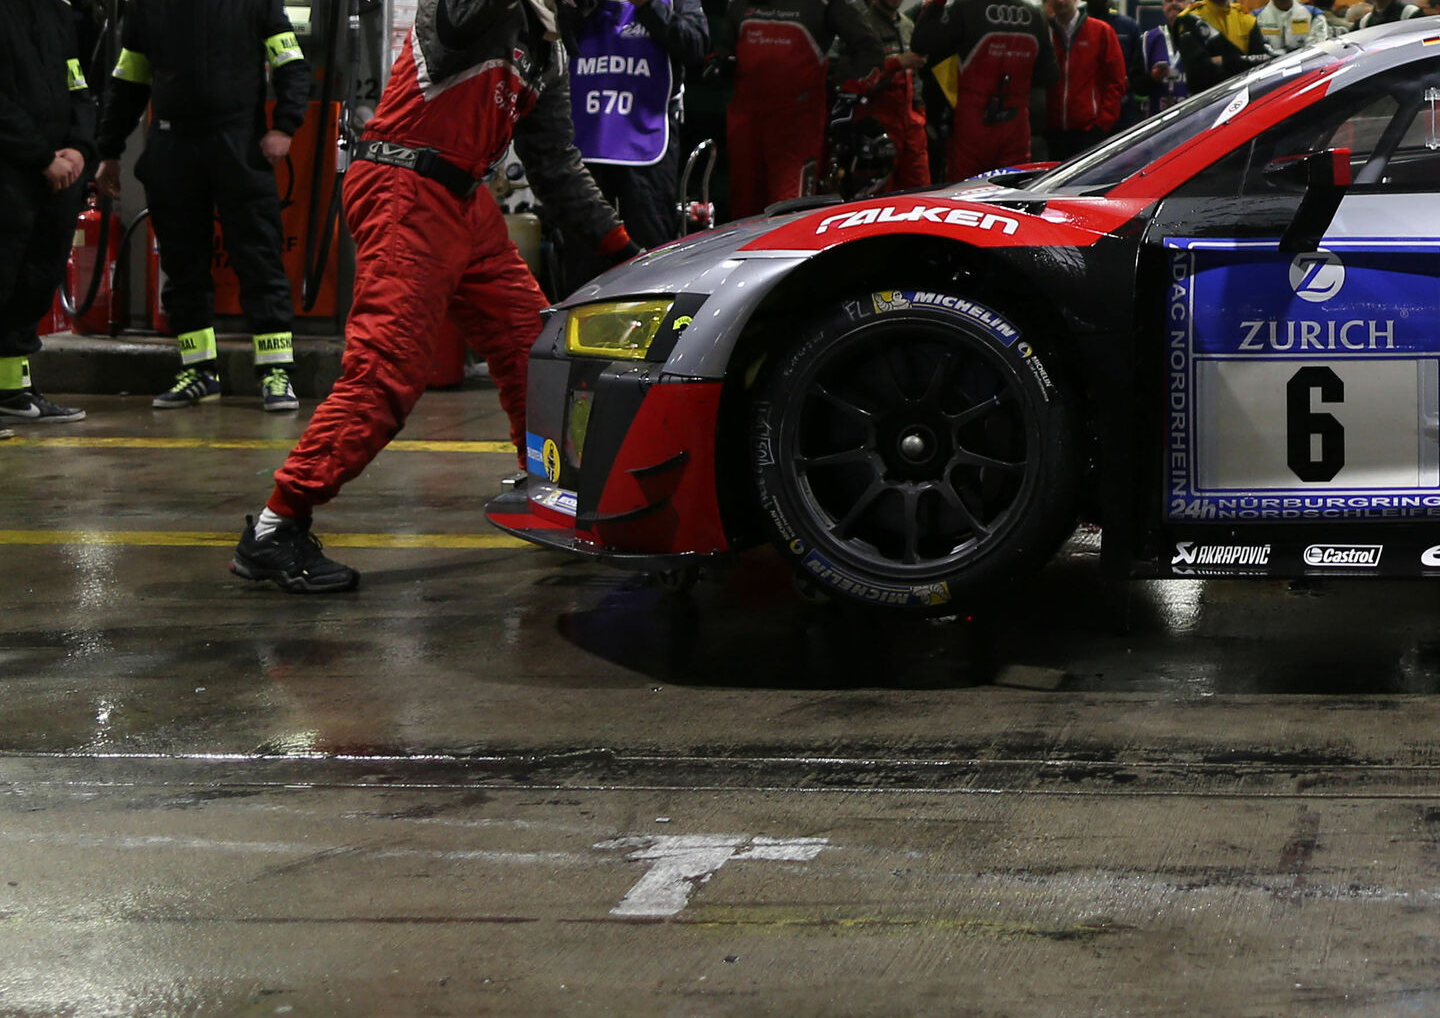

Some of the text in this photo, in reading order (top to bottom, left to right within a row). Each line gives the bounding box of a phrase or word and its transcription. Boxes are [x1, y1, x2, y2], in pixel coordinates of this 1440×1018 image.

[576, 55, 651, 78] MEDIA
[586, 89, 633, 115] 670
[815, 205, 1020, 236] FALKEN
[912, 290, 1018, 339] MICHELIN
[1238, 320, 1395, 351] ZURICH
[1031, 355, 1055, 388] MICHELIN
[1169, 243, 1187, 496] ADAC NORDRHEIN
[1286, 365, 1345, 483] 6
[1169, 497, 1217, 520] 24h
[1321, 548, 1375, 564] Castrol
[806, 558, 909, 605] MICHELIN
